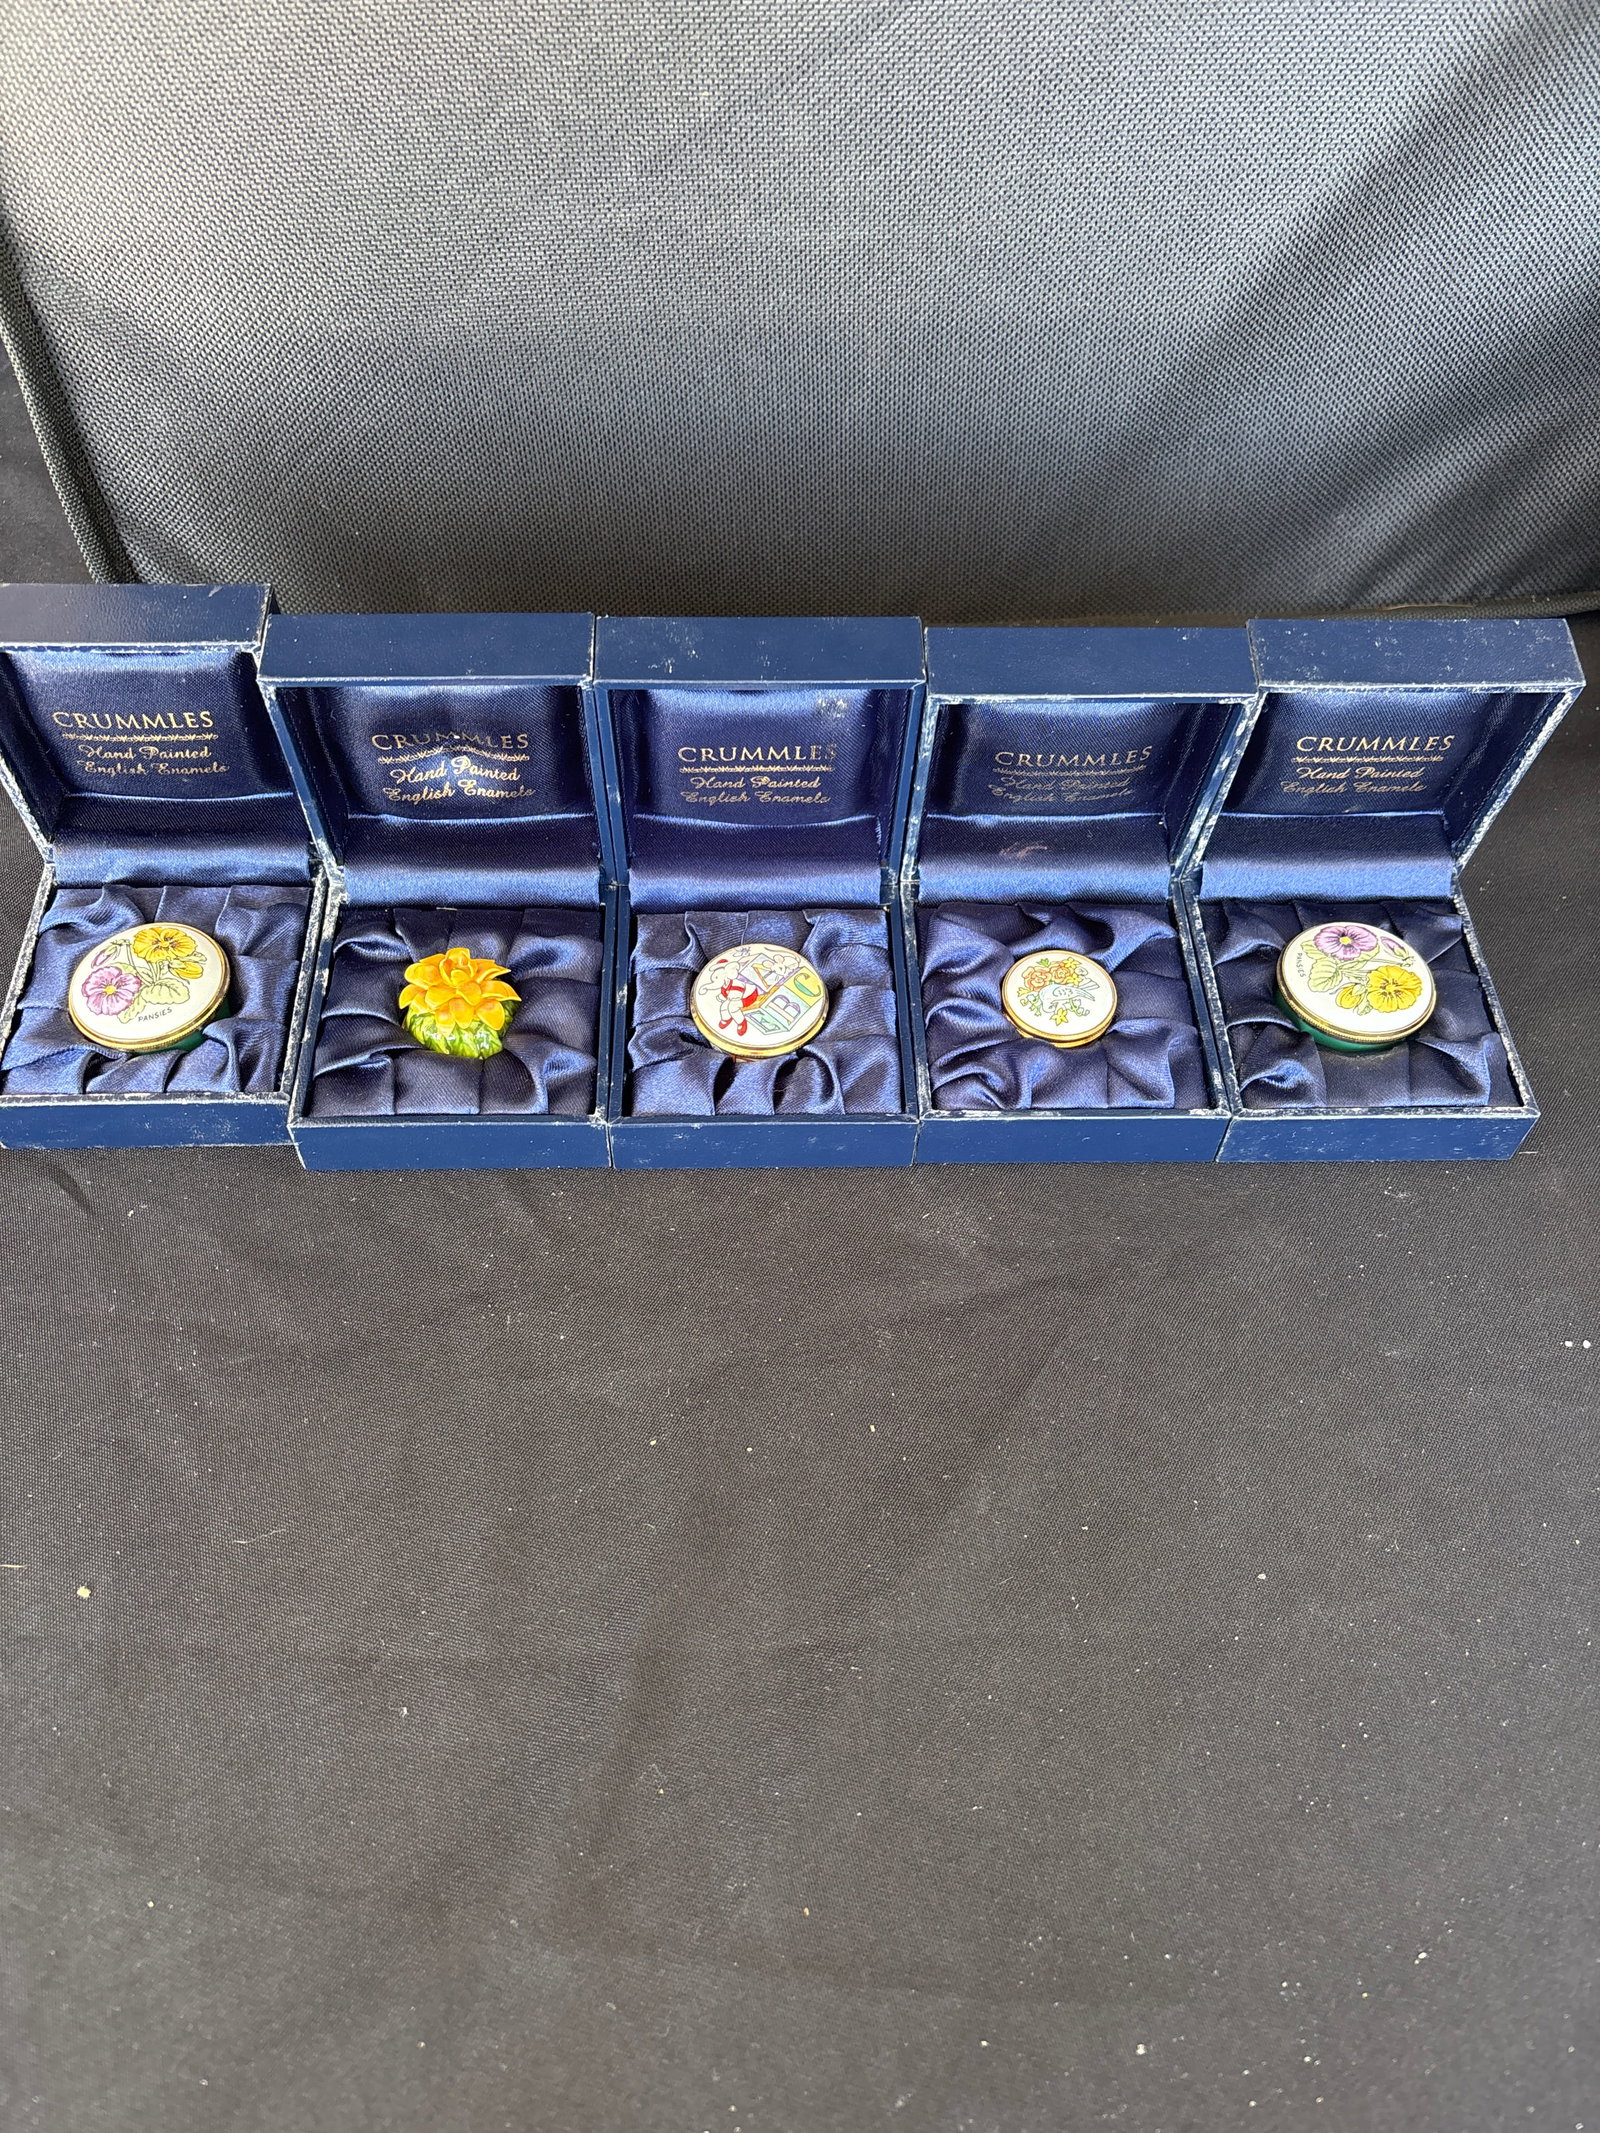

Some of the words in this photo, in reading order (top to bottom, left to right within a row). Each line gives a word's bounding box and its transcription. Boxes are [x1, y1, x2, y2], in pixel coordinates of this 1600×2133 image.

[52, 711, 214, 729] CRUMMLES
[371, 731, 529, 750] CRUMMLES
[1296, 735, 1456, 752] CRUMMLES
[78, 744, 136, 760] Hand
[138, 746, 212, 760] Painted
[678, 742, 838, 762] CRUMMLES
[994, 745, 1153, 767] CRUMMLES
[77, 761, 149, 777] English
[150, 761, 230, 775] Enamels
[390, 760, 448, 785] Hand
[451, 755, 520, 781] Painted
[1296, 766, 1351, 779] Hand
[1354, 766, 1426, 779] Painted
[690, 776, 746, 789] Hand
[750, 775, 821, 789] Painted
[1001, 776, 1057, 791] Hand
[1280, 781, 1347, 797] English
[1353, 781, 1427, 793] Enamels
[382, 781, 455, 805] English
[457, 778, 536, 798] Enamels
[680, 791, 751, 806] English
[754, 791, 831, 804] Enamels
[138, 1006, 173, 1022] PANSIES
